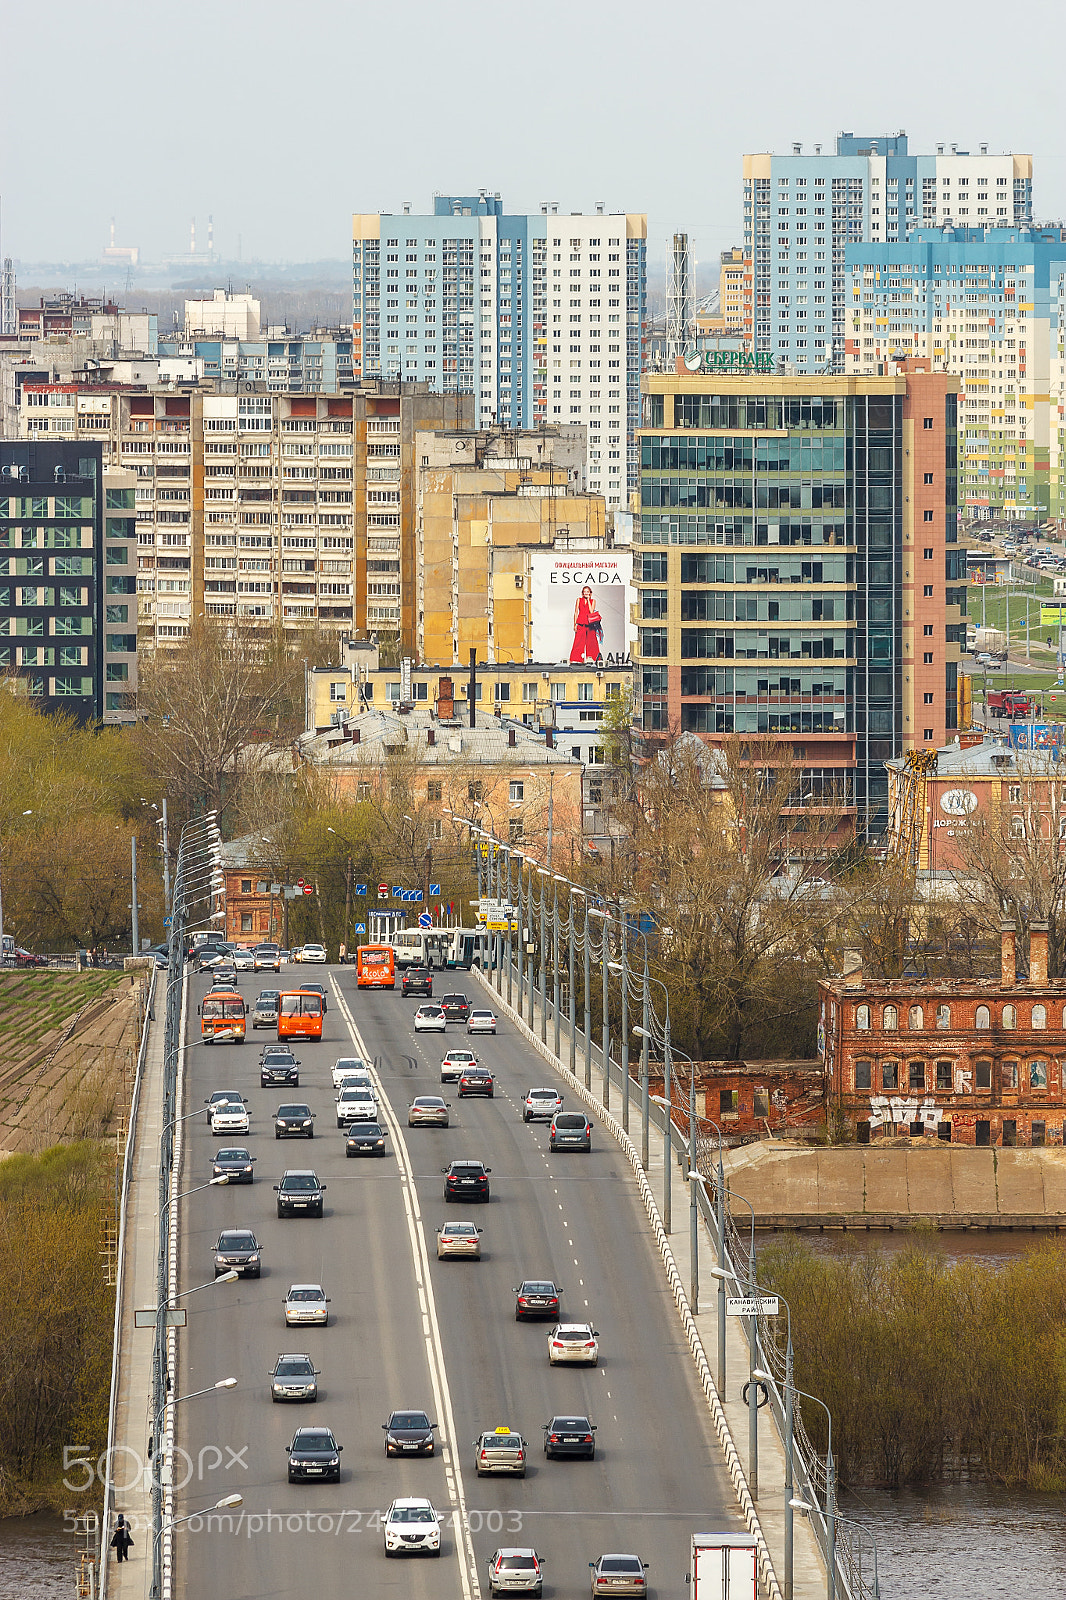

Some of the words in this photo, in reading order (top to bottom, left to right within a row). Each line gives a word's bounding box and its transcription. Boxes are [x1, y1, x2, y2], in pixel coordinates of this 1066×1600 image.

[705, 351, 775, 366] СБЕРБАНК
[554, 561, 594, 569] ОФИЦИАЛЬНЫЙ
[550, 571, 622, 584] ESCADA
